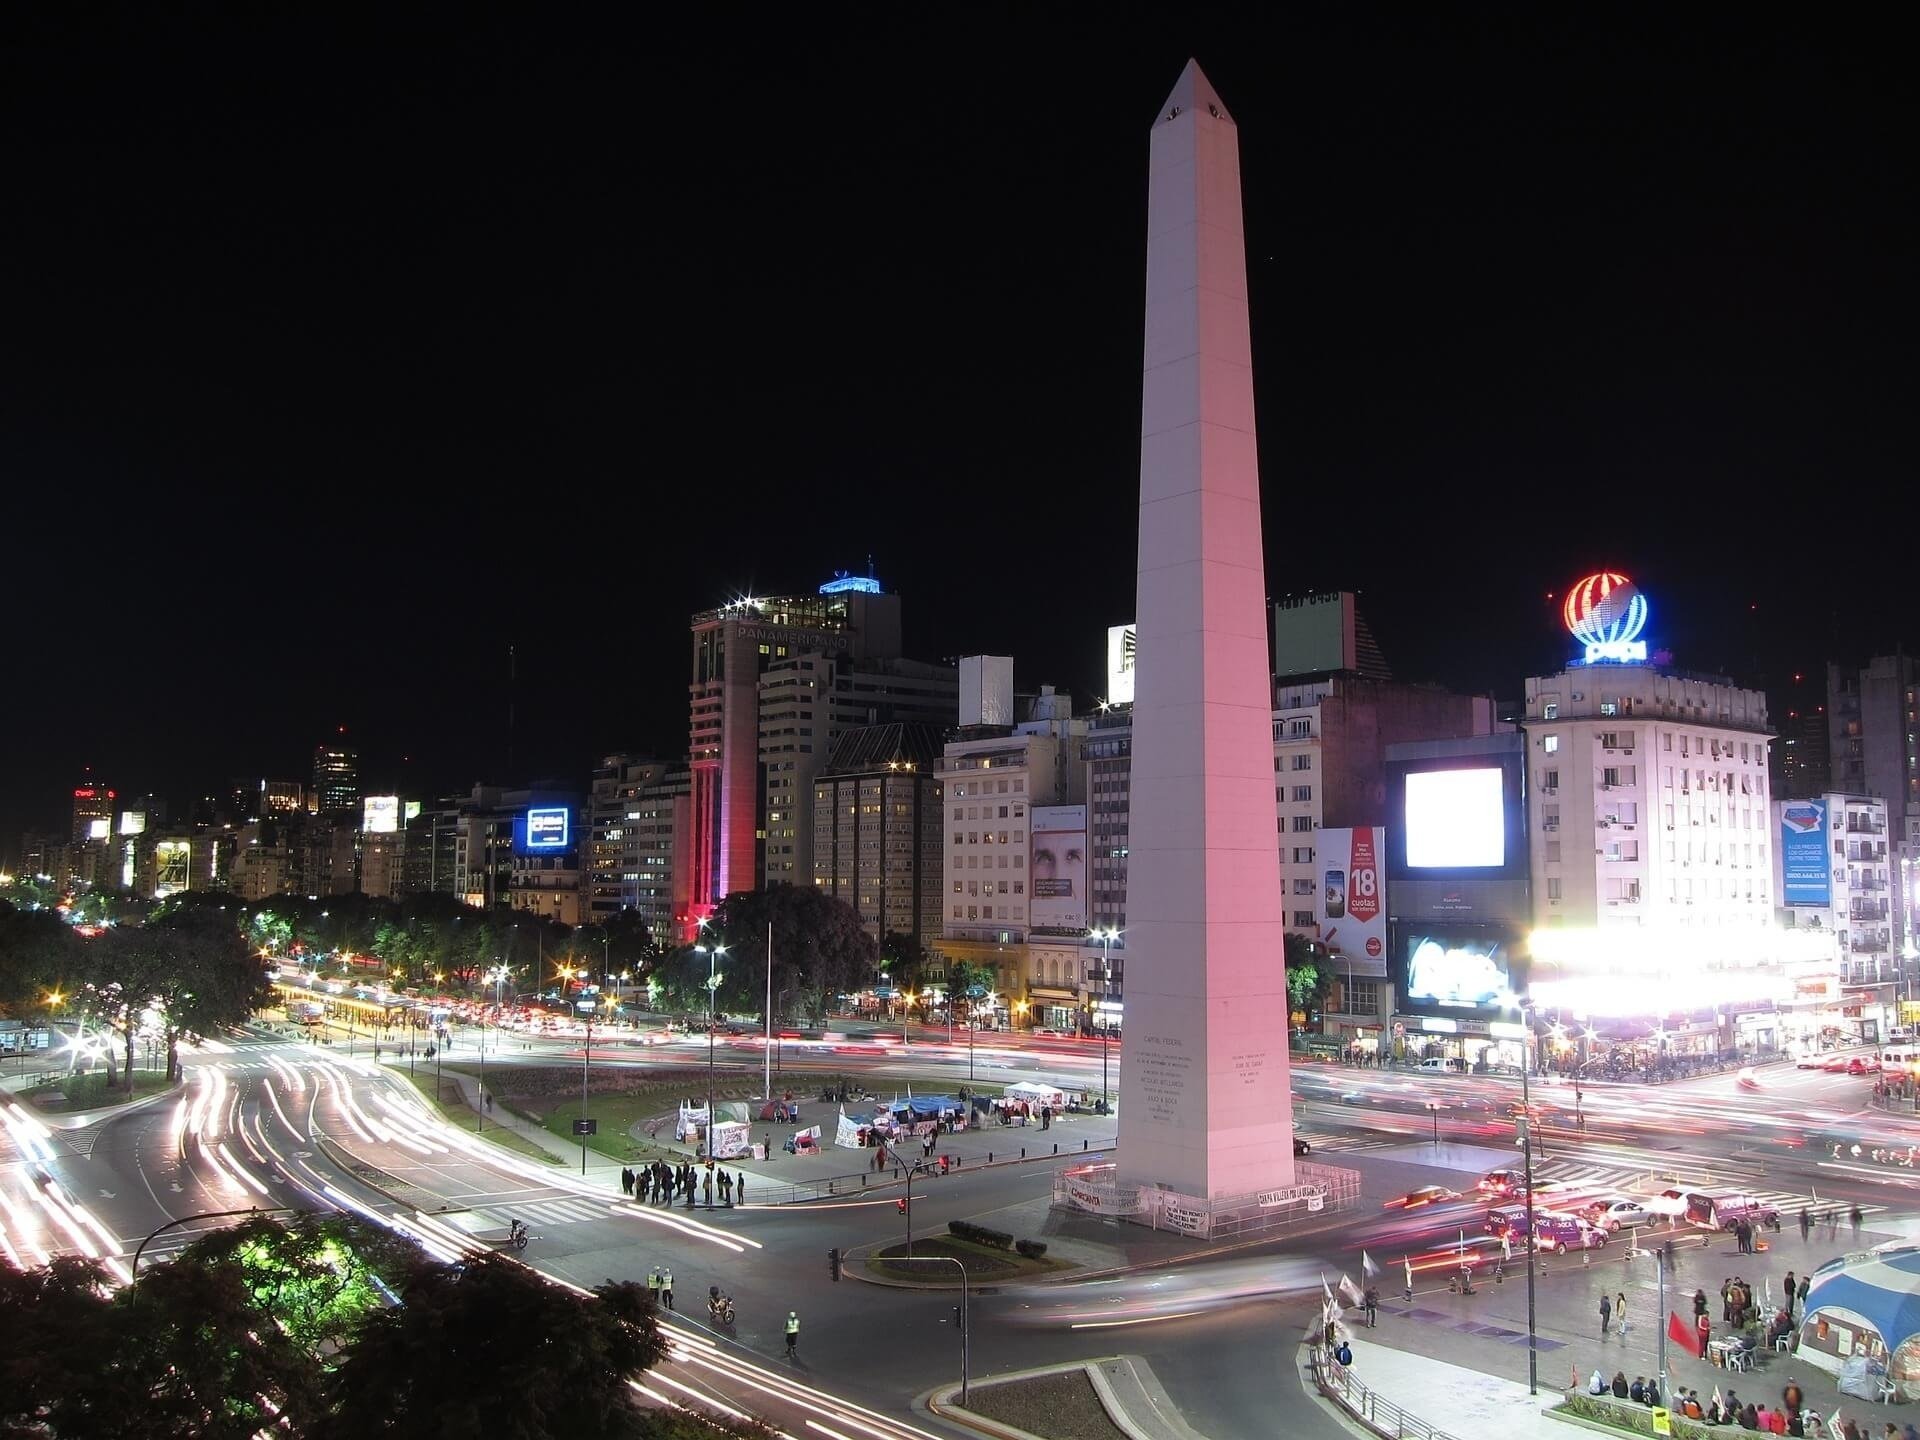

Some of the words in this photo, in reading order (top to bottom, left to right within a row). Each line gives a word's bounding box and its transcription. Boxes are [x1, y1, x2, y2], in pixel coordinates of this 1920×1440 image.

[738, 626, 847, 649] PANAMERICANO
[1352, 869, 1376, 896] 18
[1352, 899, 1376, 907] cuotas
